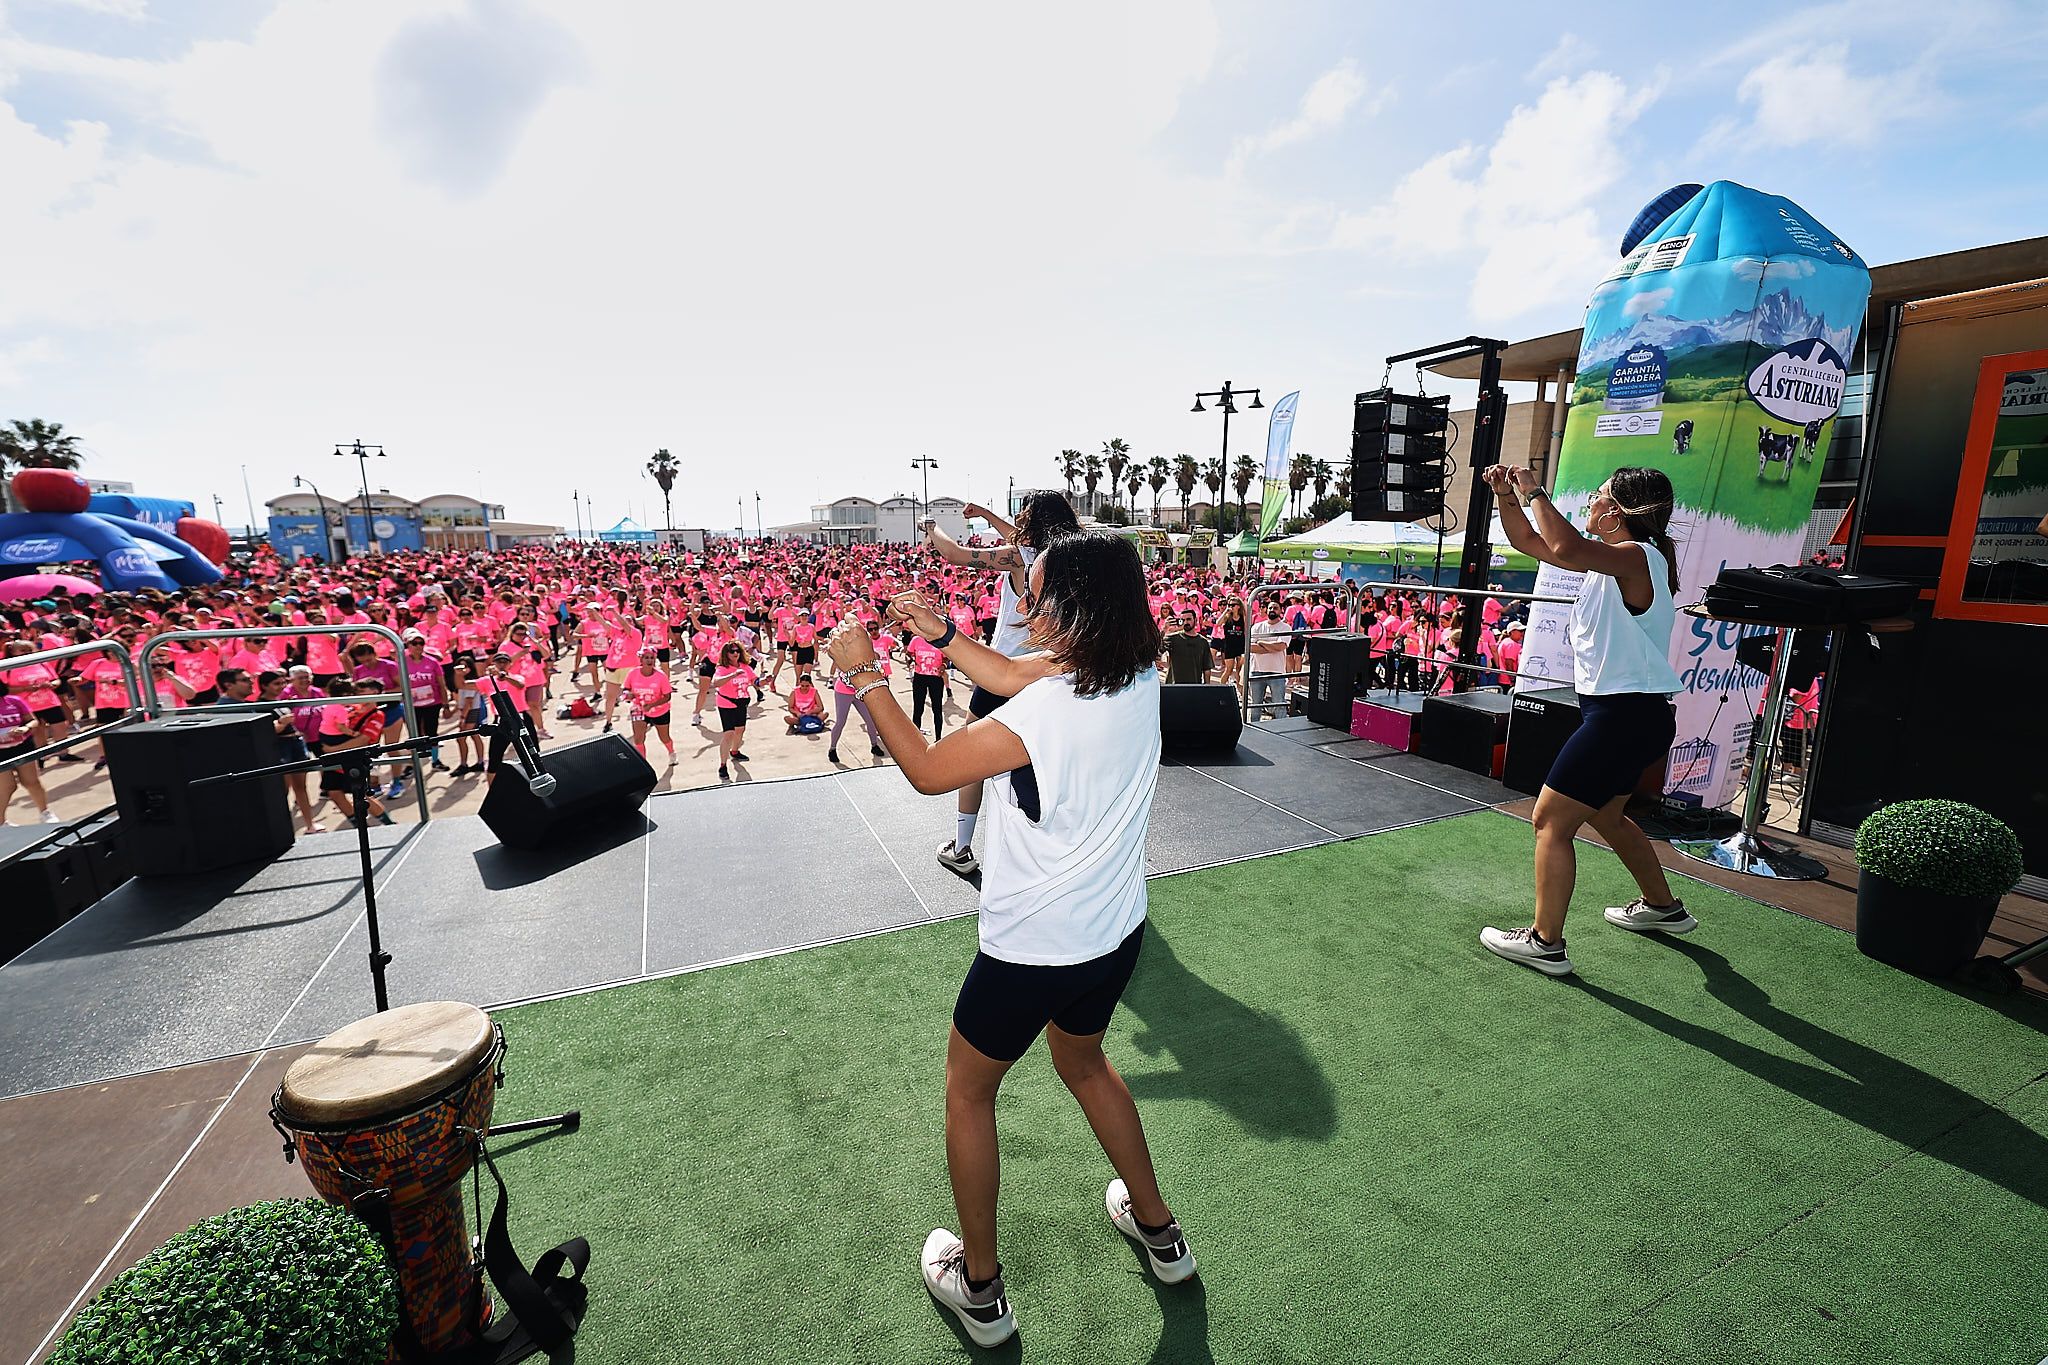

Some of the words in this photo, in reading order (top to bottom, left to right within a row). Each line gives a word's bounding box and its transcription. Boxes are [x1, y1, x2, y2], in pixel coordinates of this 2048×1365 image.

[1615, 363, 1661, 377] GARANTÍA
[1781, 365, 1814, 378] CENTRAL
[1814, 370, 1842, 383] LECHERA
[1611, 373, 1661, 385] GANADERA
[1753, 364, 1840, 409] ASTURIANA
